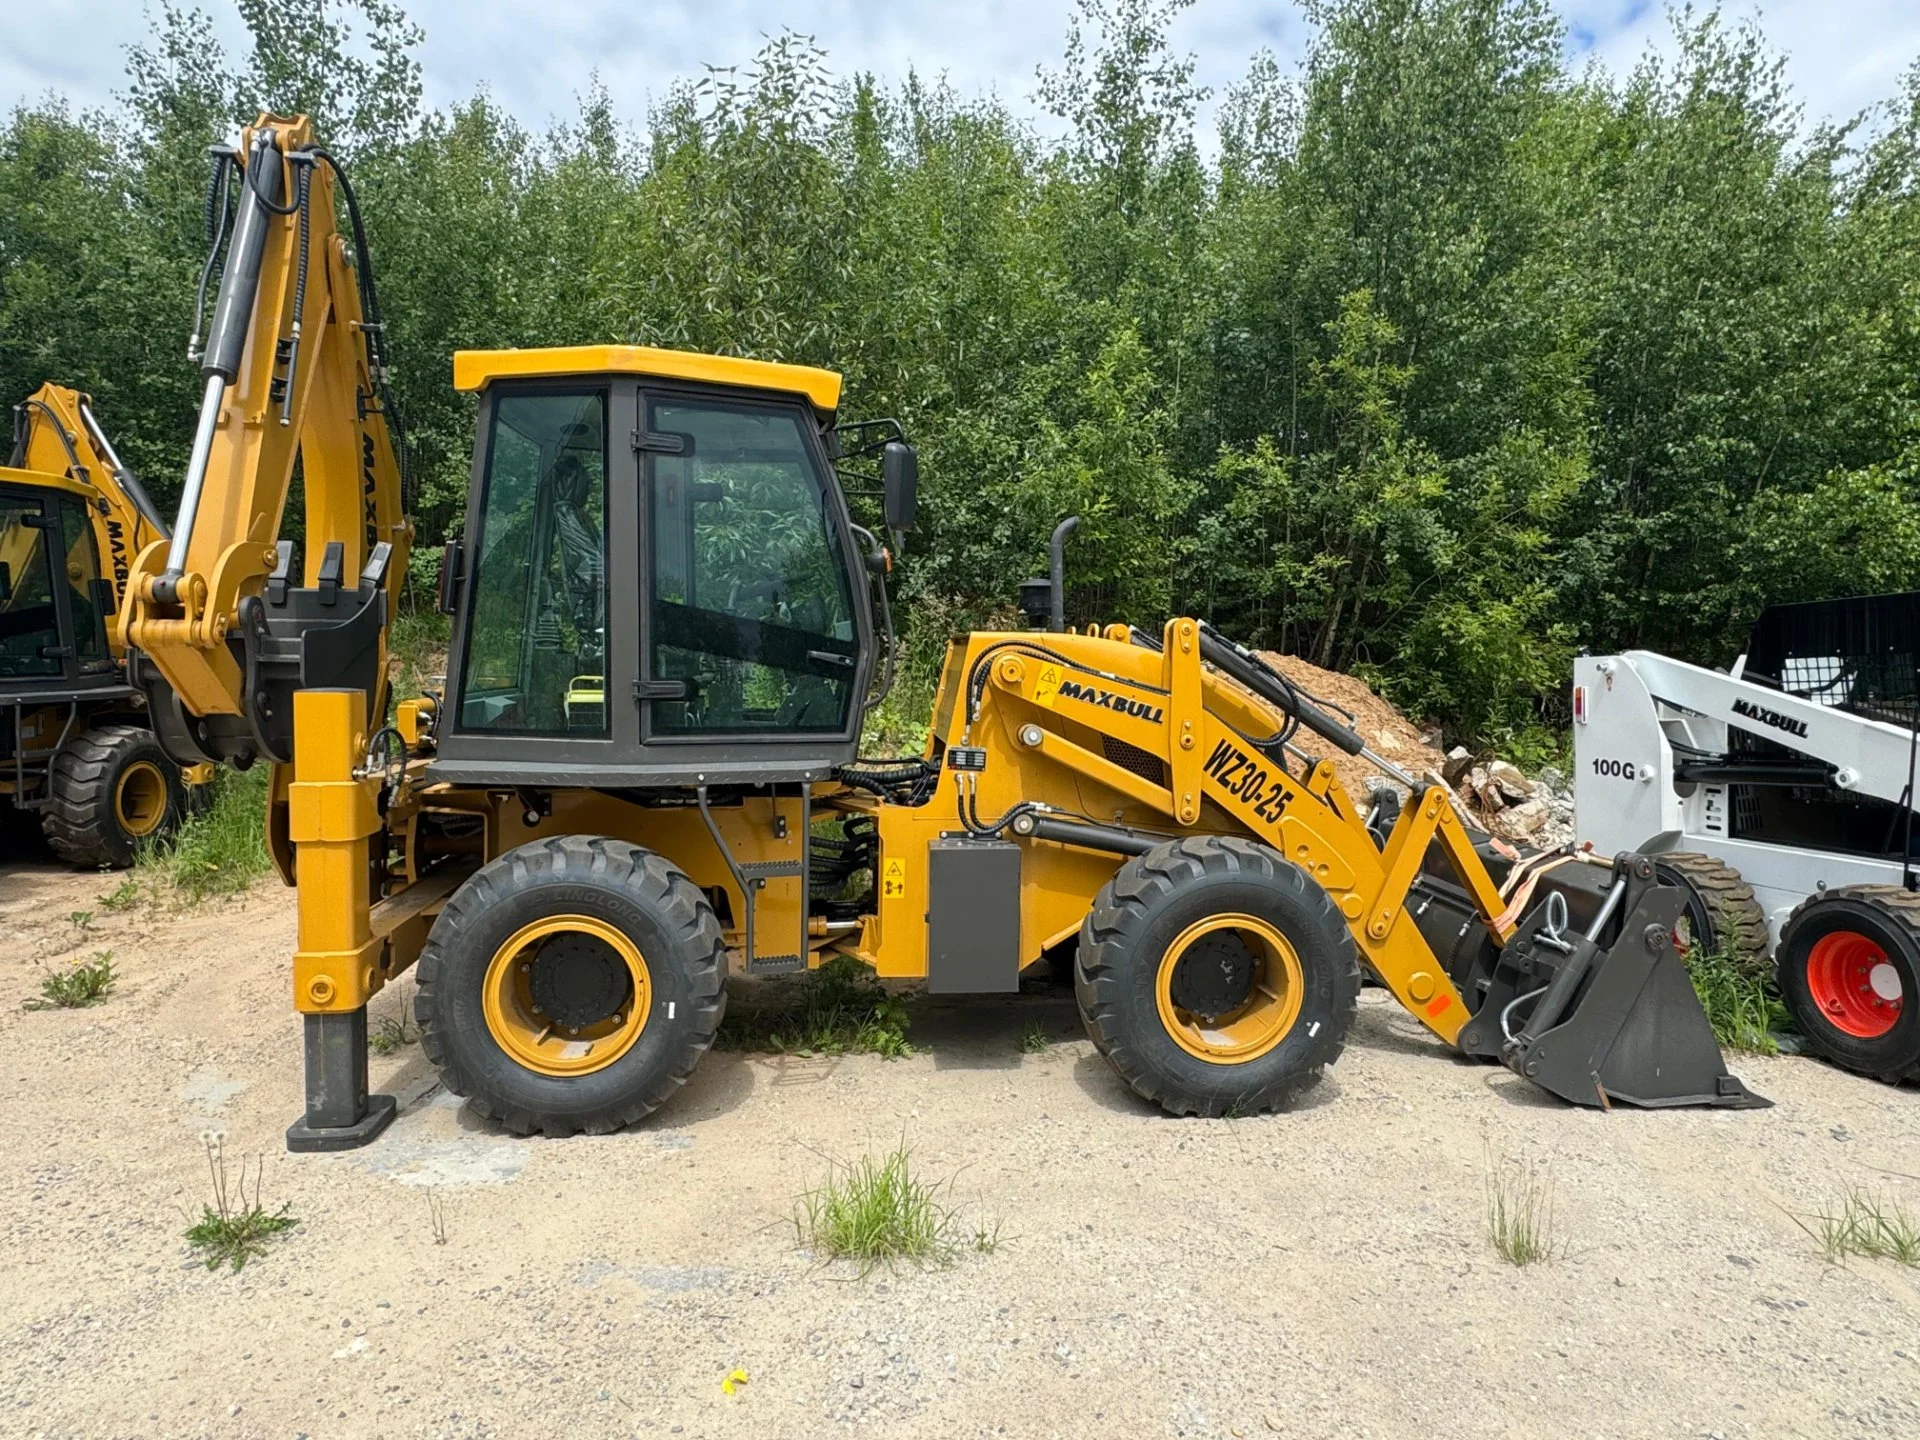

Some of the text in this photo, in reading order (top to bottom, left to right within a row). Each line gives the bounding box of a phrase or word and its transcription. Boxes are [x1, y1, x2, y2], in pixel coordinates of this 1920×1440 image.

[1058, 680, 1163, 725] MAXBULL
[1730, 699, 1809, 739] MAXBULL
[1203, 738, 1295, 824] WZ30-25
[1592, 758, 1635, 781] 100G
[554, 888, 642, 923] LINGLONG
